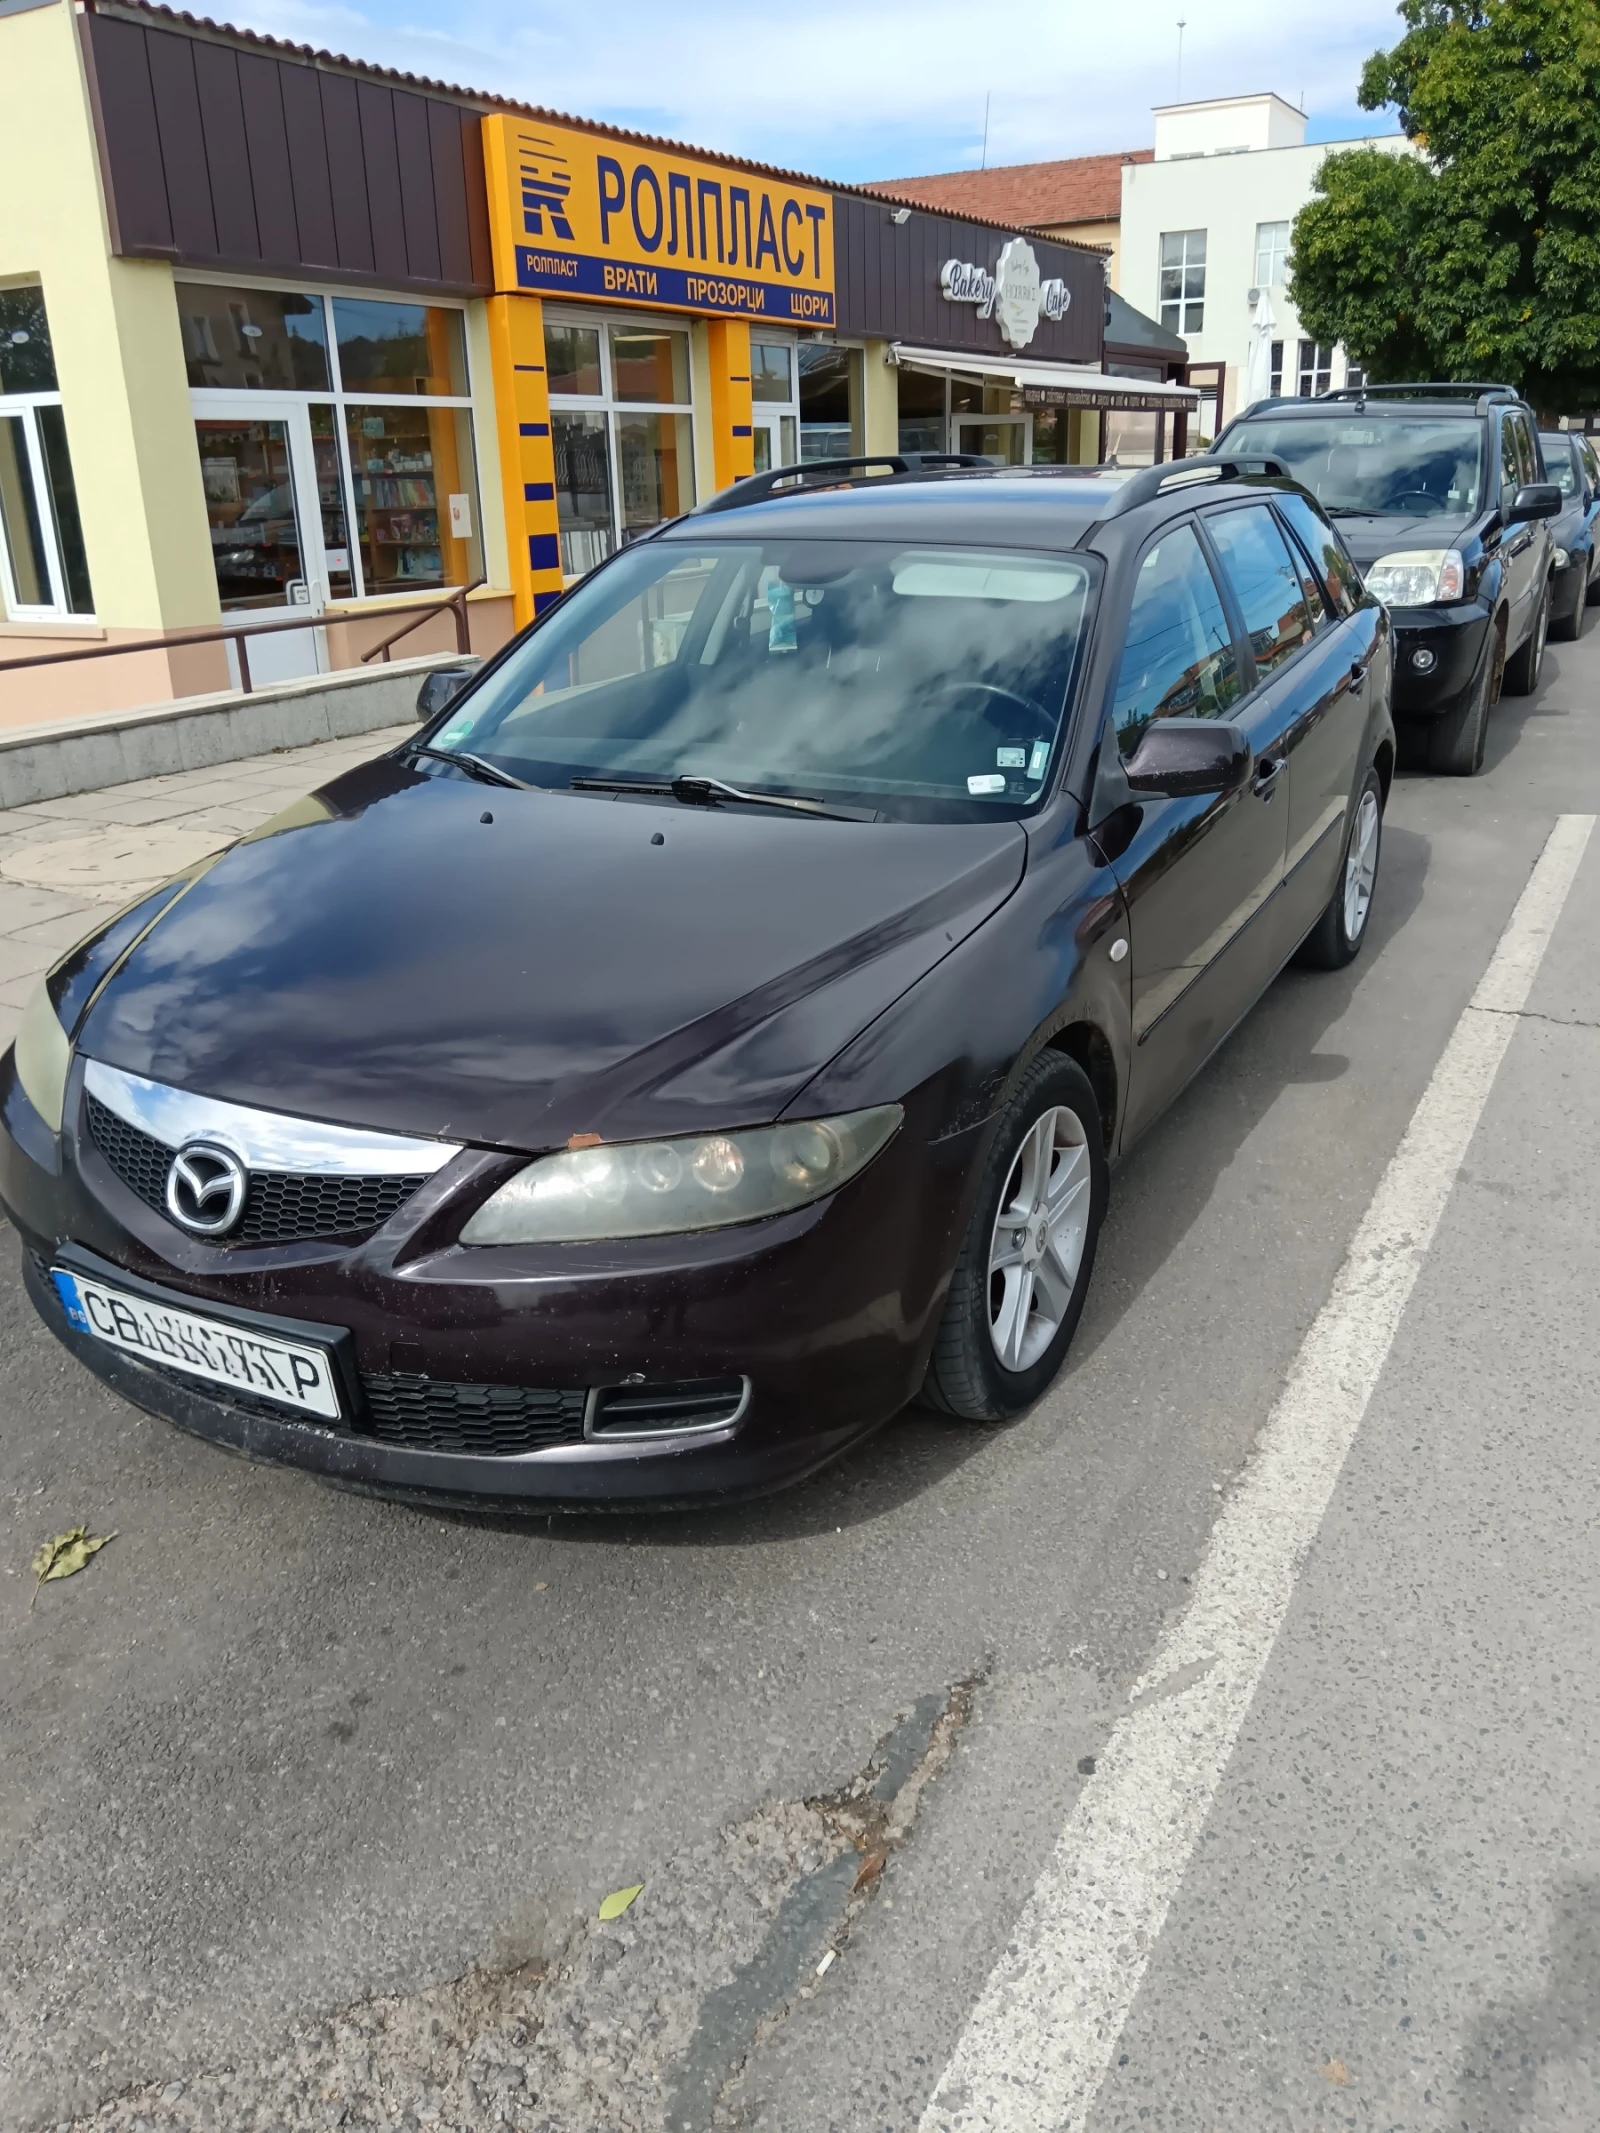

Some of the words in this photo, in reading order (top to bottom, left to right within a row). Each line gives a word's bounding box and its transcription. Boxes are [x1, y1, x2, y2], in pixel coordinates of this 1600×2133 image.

[597, 154, 826, 280] РОЛПЛАСТ
[526, 254, 579, 278] РОЛПЛАСТ
[603, 265, 658, 296] ВРАТИ
[687, 277, 765, 312] ПРОЗОРЦИ
[790, 292, 829, 318] ЩОРИ
[949, 263, 996, 315] Bakery
[1046, 279, 1068, 318] Cafe
[68, 1306, 88, 1324] BG
